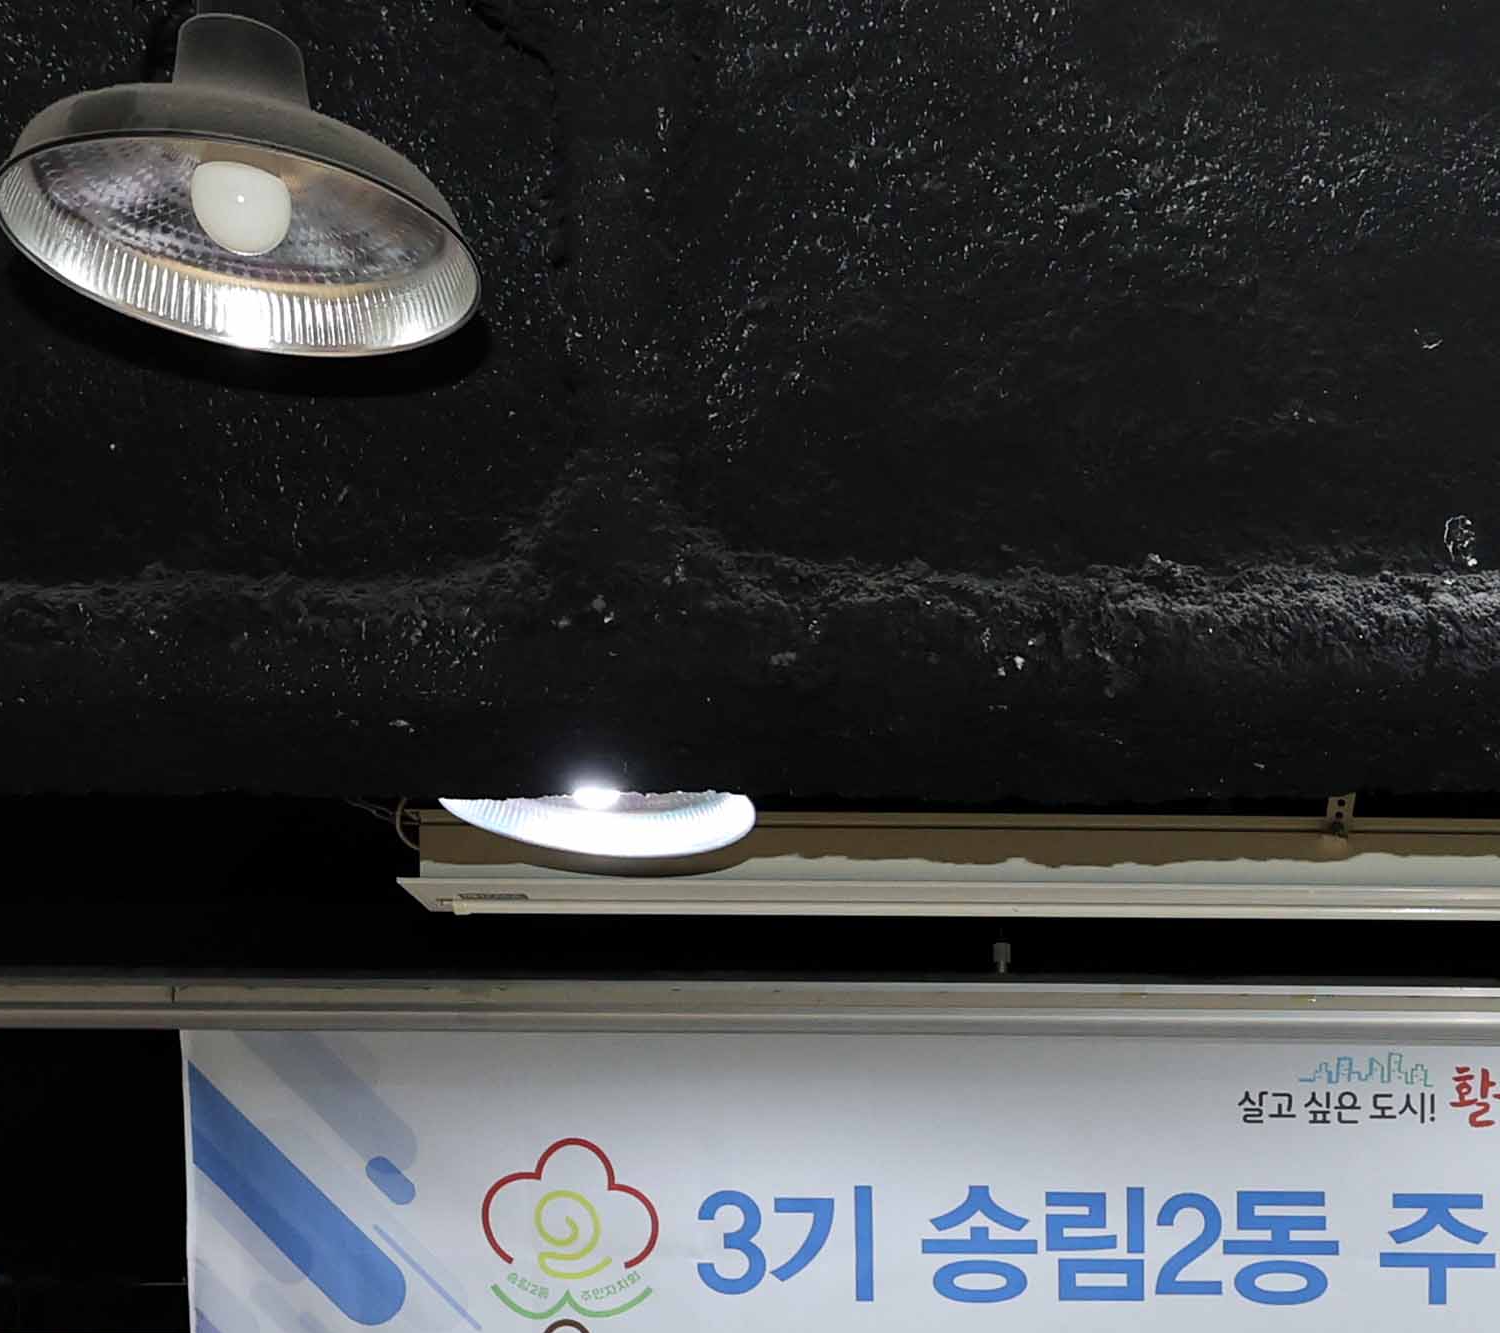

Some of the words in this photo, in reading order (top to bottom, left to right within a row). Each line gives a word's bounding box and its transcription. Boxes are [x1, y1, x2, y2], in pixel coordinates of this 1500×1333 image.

[1237, 1090, 1297, 1125] 살고
[1303, 1090, 1362, 1125] 싶은
[1369, 1090, 1437, 1125] 도시!
[696, 1185, 875, 1302] 3기
[920, 1185, 1341, 1307] 송림2동
